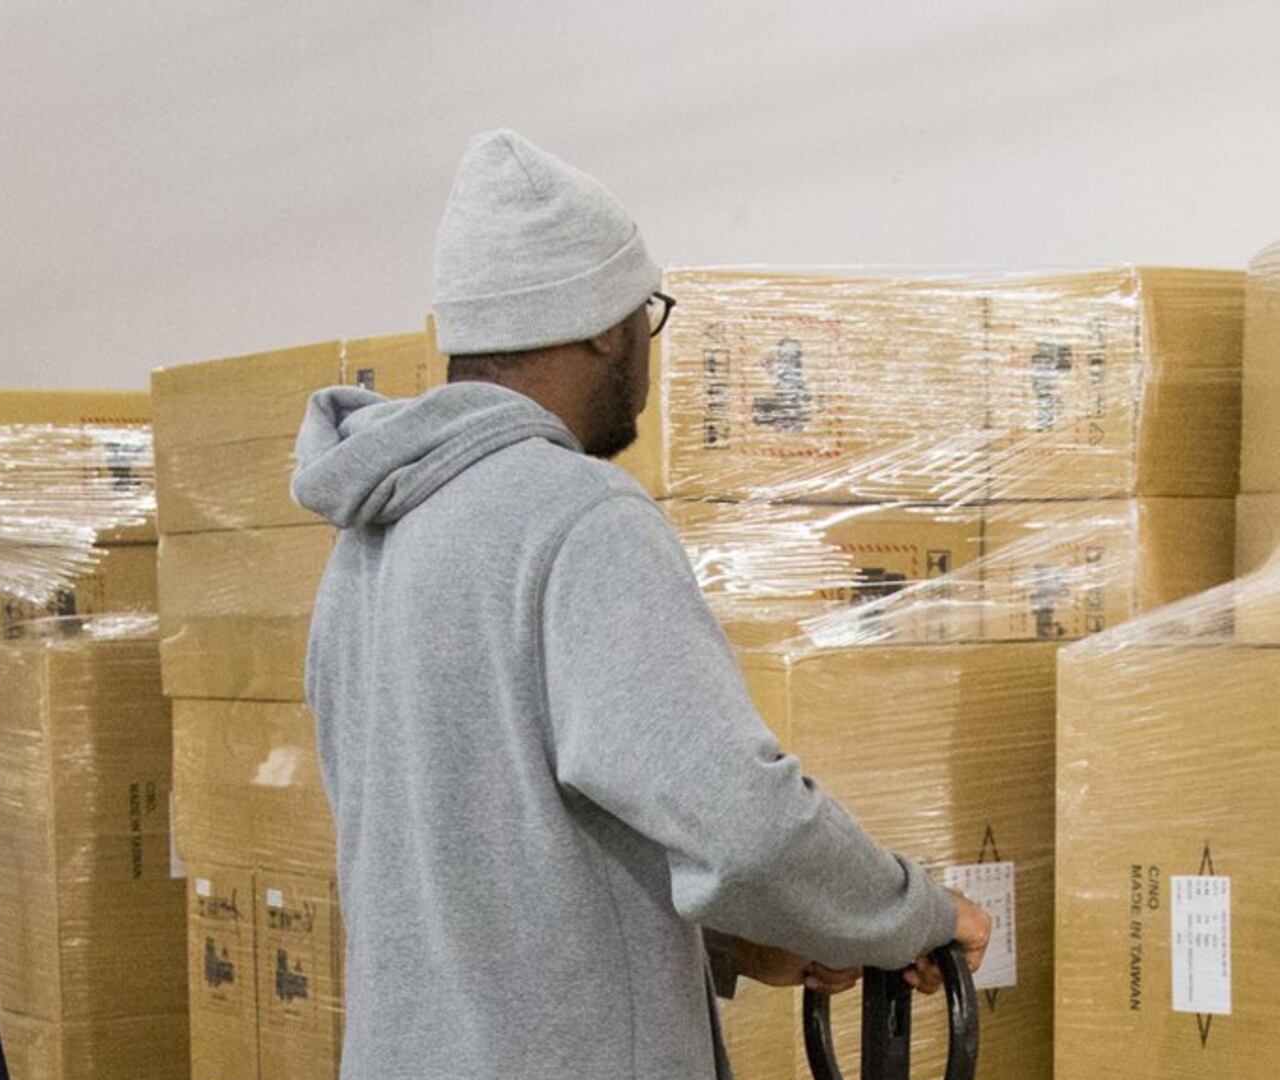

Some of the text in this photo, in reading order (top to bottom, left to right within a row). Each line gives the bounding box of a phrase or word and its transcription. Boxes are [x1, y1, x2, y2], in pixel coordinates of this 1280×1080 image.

[1130, 864, 1142, 1011] MADE IN TAIWAN
